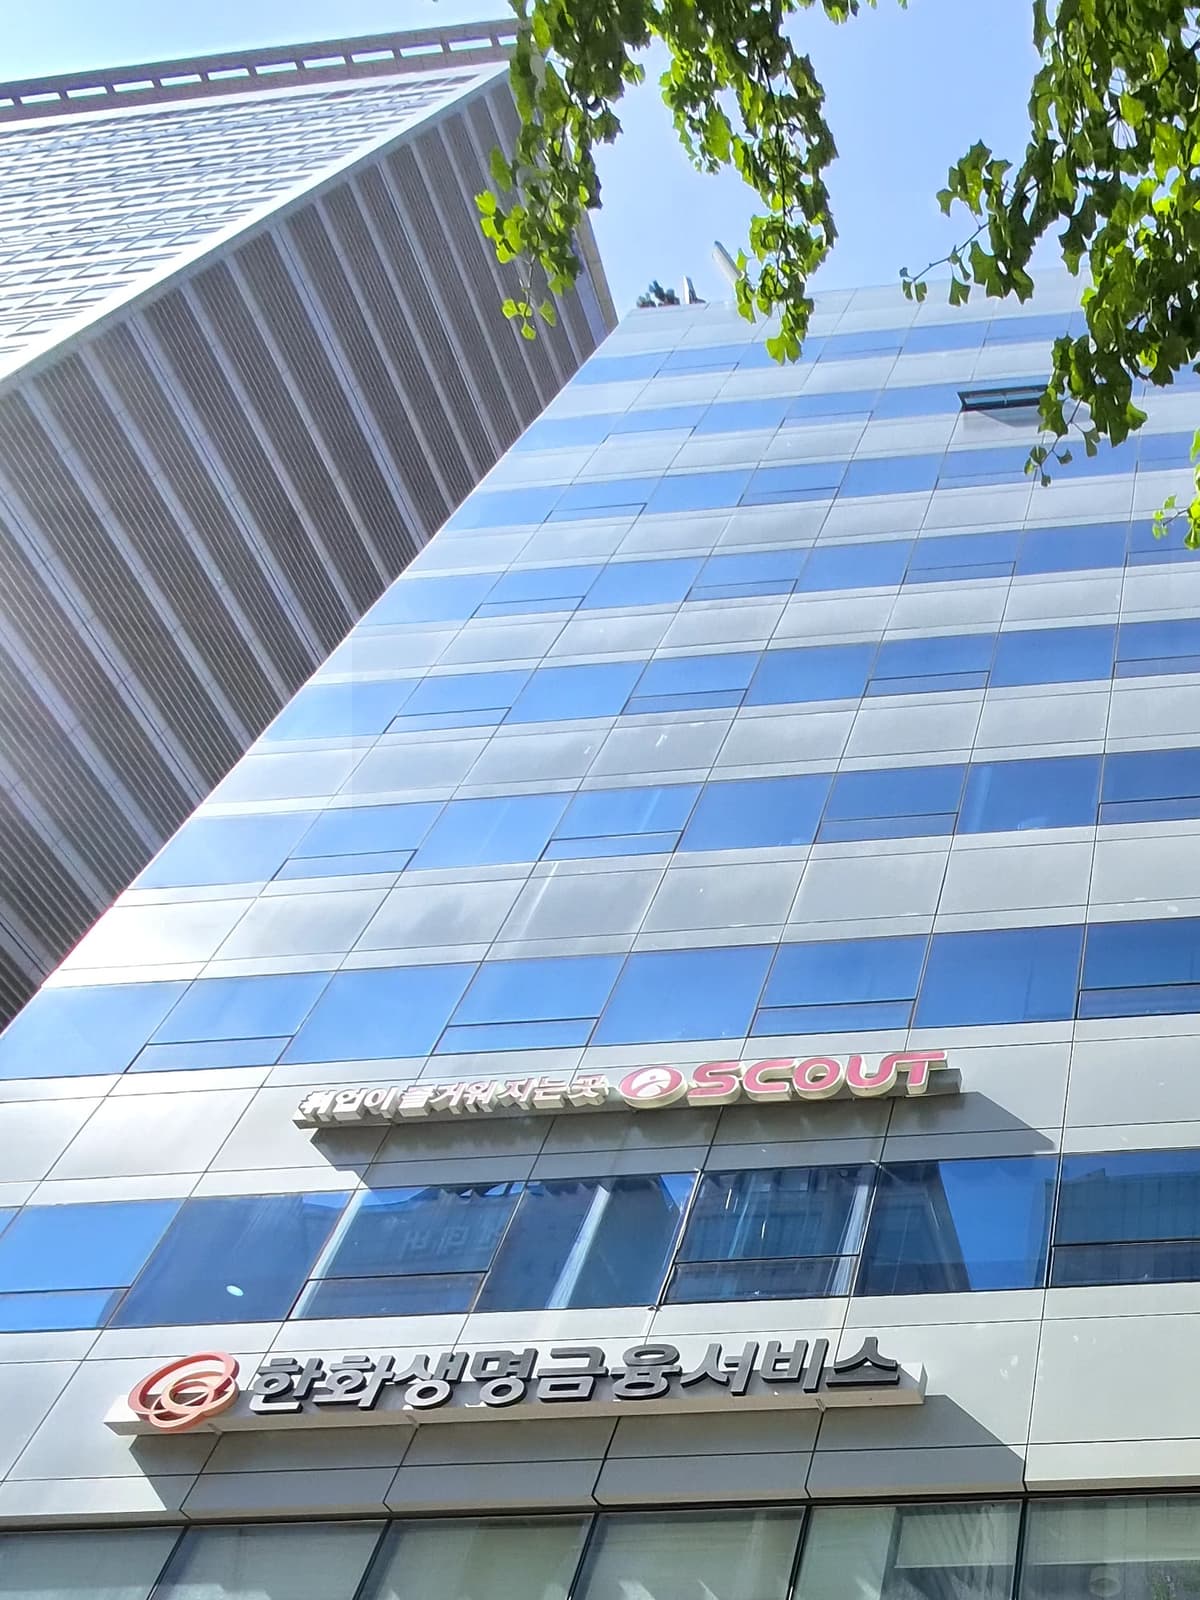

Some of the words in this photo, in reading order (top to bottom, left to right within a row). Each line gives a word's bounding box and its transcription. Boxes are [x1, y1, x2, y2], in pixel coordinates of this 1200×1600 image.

[300, 1086, 398, 1121] 취업이
[687, 1050, 949, 1107] SCOUT
[248, 1336, 902, 1413] 한화생명금융서비스
